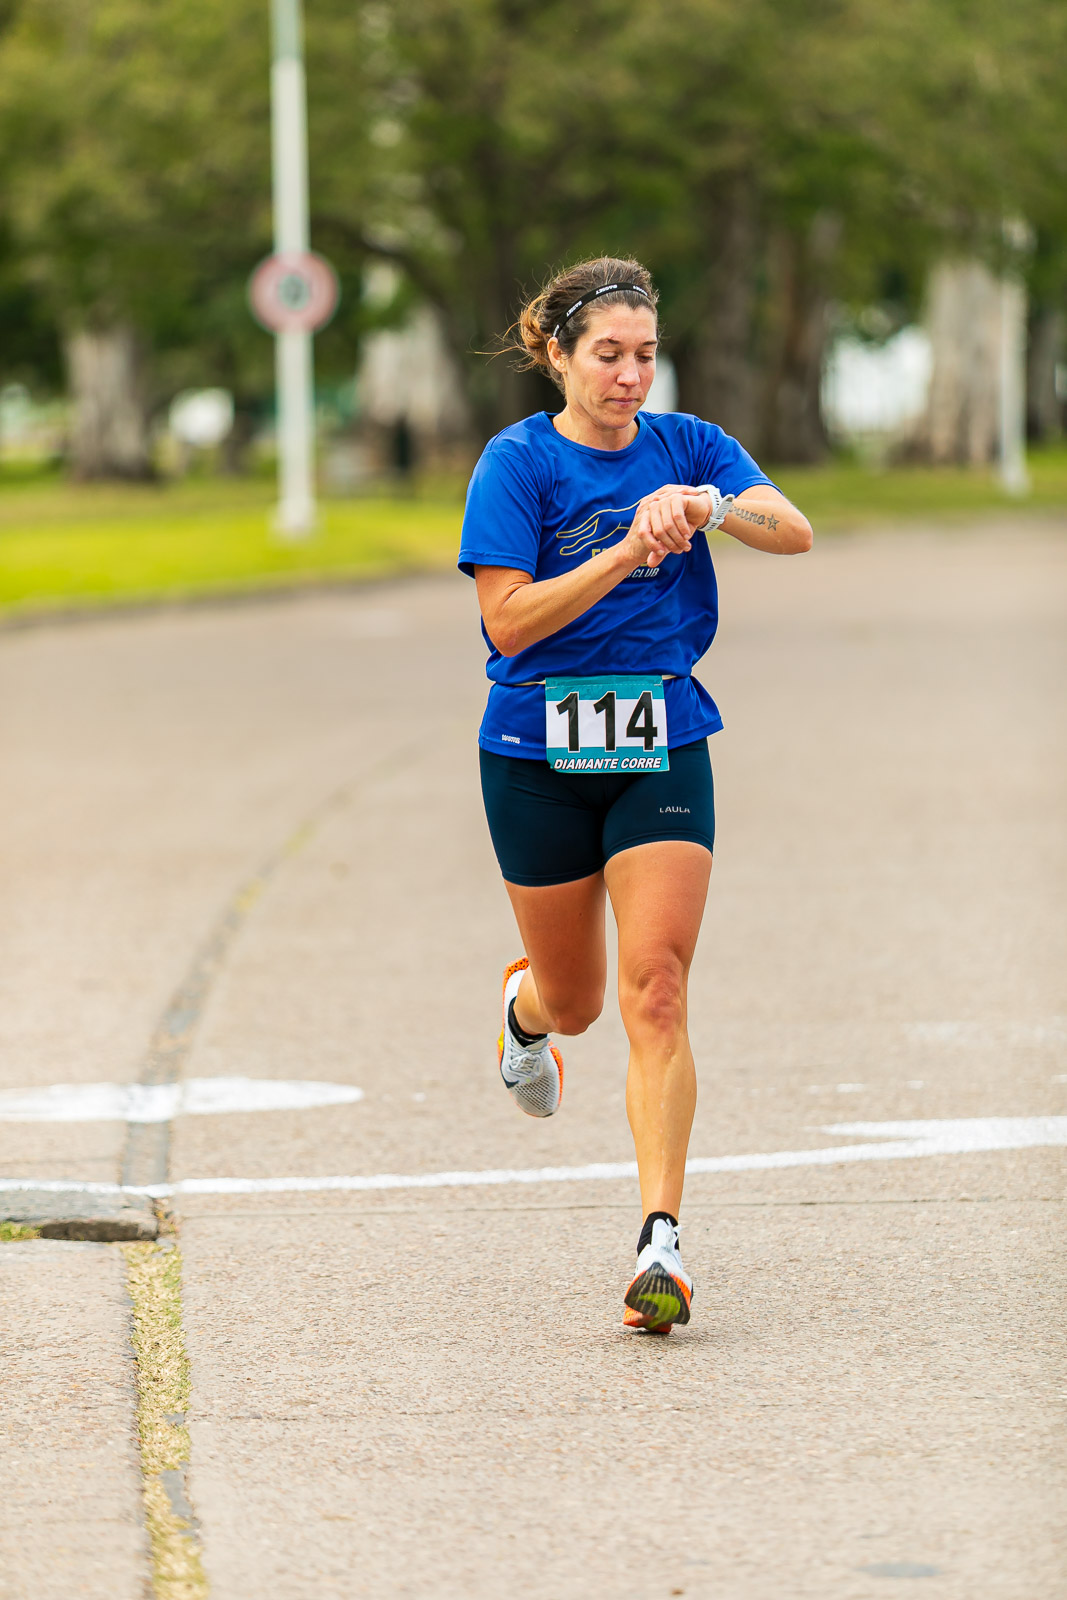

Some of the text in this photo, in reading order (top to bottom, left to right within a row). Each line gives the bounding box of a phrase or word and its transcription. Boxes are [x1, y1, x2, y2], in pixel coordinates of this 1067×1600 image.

[632, 567, 660, 578] CLUB
[556, 691, 658, 753] 114
[553, 757, 662, 770] DIAMANTE CORRE
[659, 805, 691, 814] LAULA
